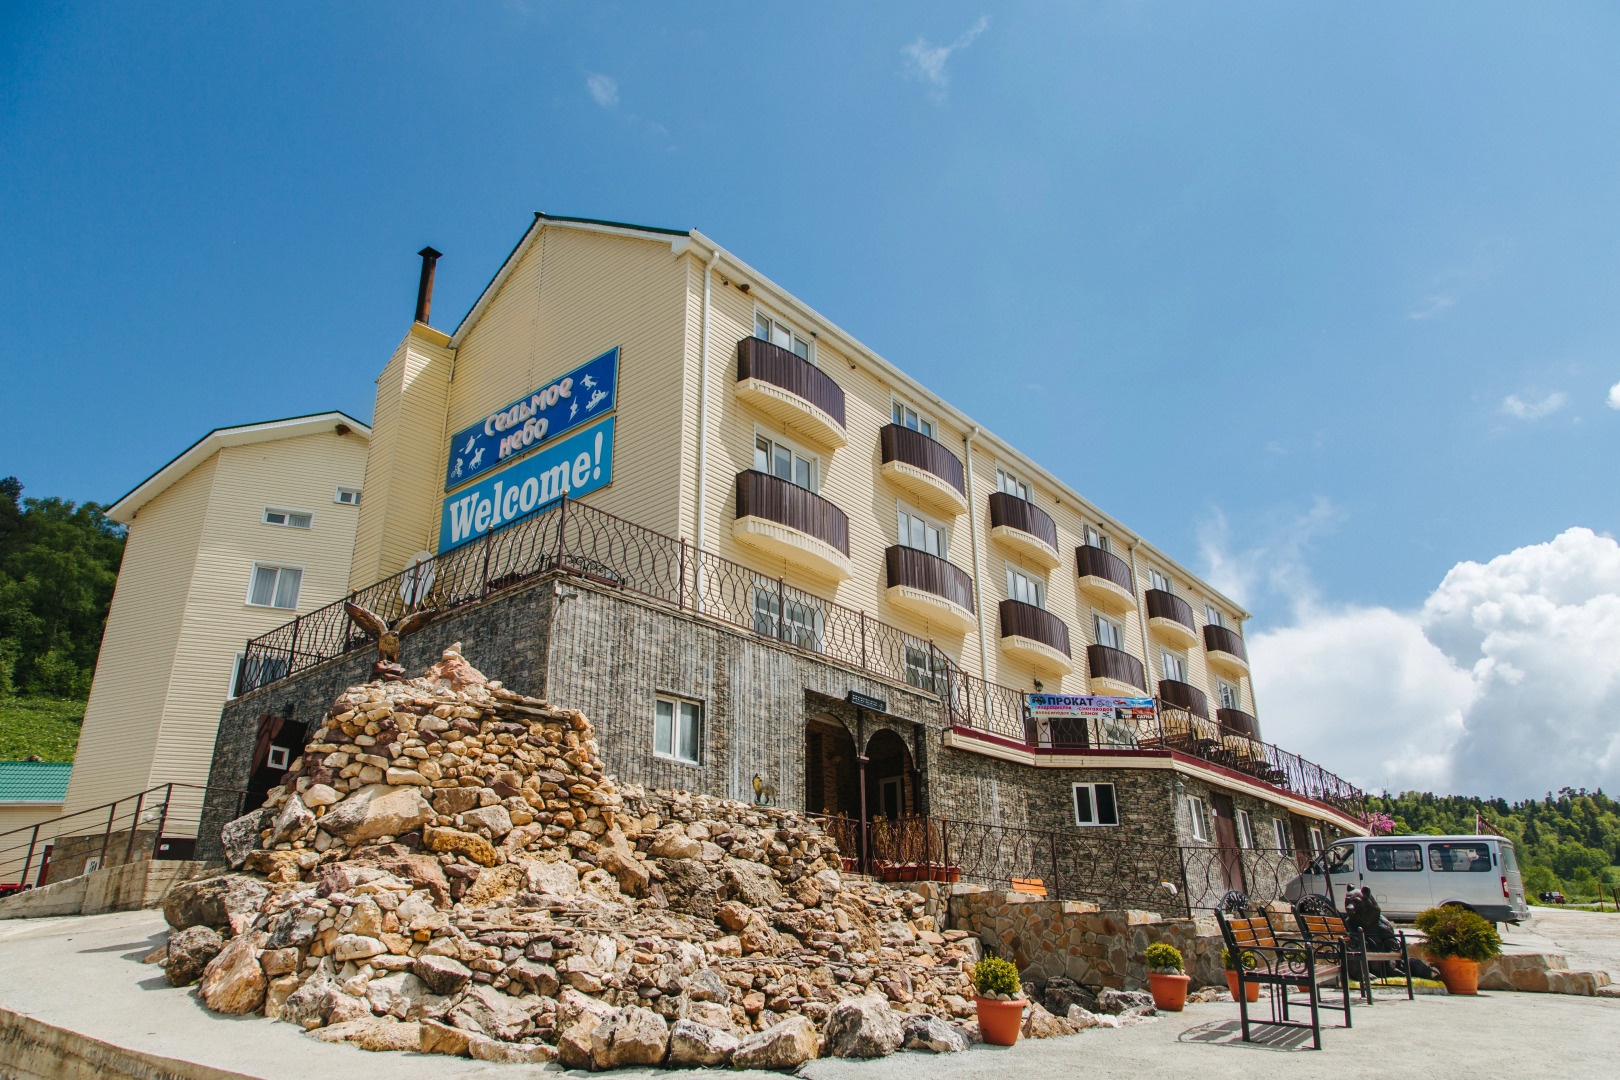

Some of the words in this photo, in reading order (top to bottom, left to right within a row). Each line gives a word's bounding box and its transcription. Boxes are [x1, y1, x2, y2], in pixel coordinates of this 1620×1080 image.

[498, 417, 550, 460] небо
[450, 431, 604, 544] Welcome!
[1047, 697, 1094, 706] ПРОКАТ
